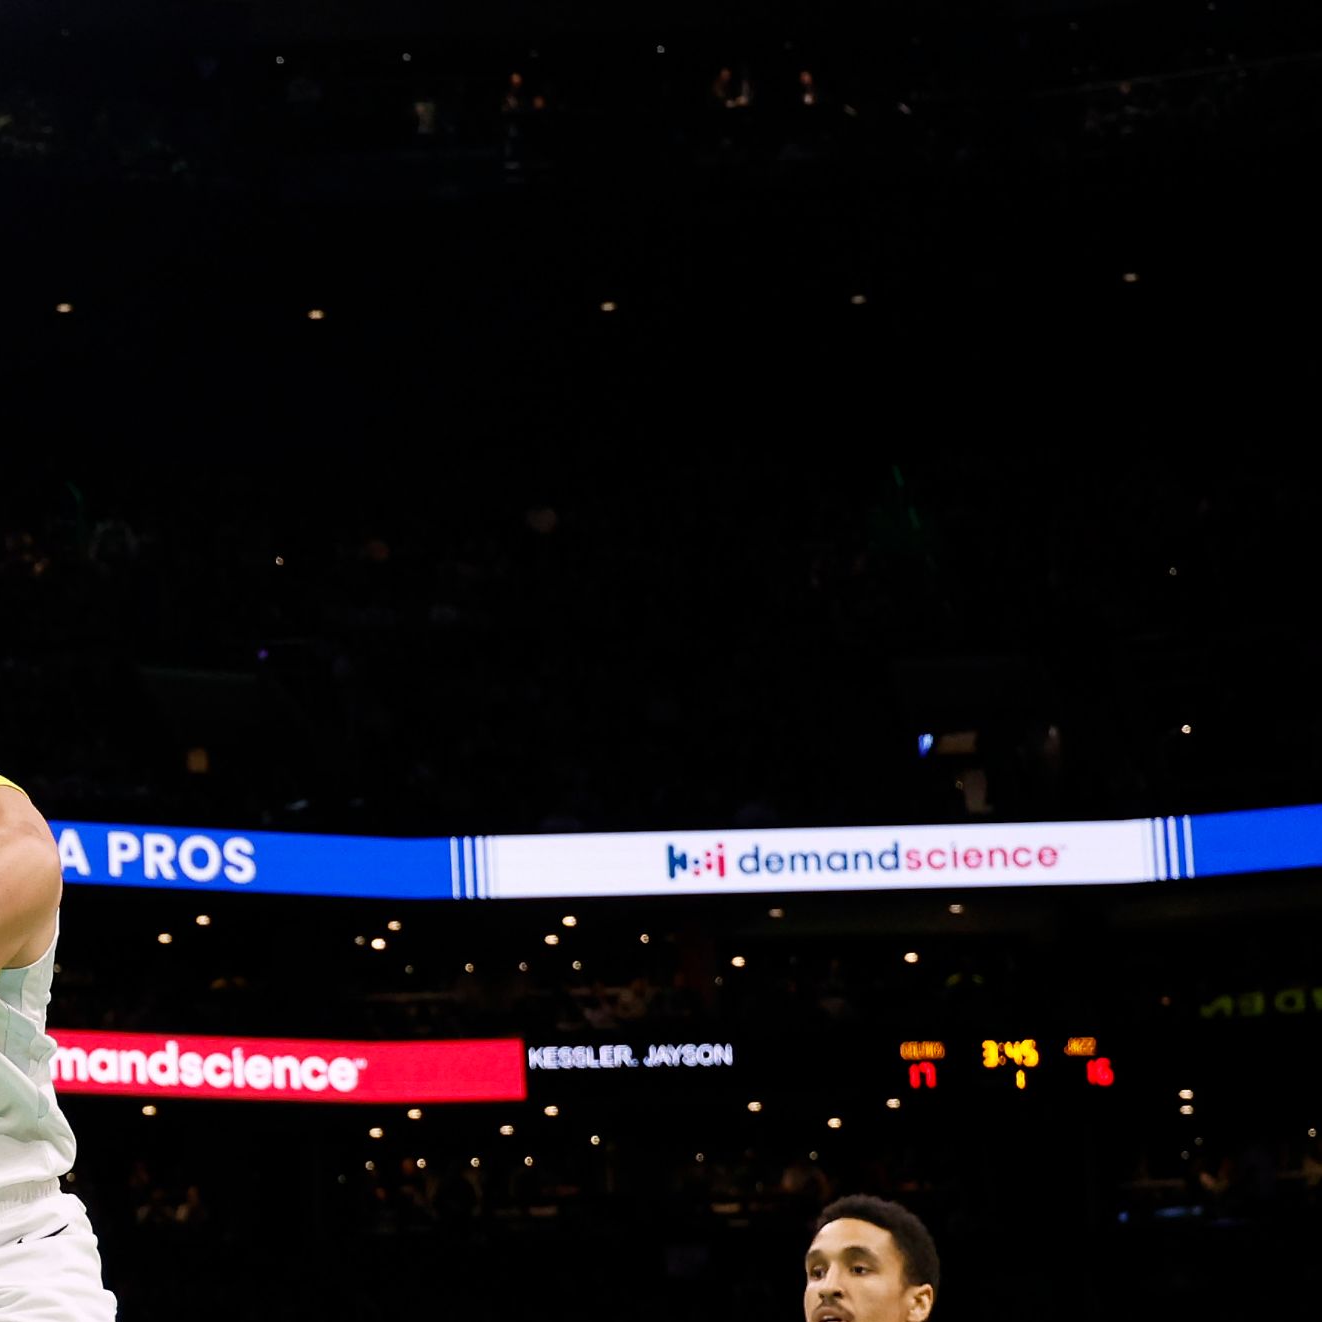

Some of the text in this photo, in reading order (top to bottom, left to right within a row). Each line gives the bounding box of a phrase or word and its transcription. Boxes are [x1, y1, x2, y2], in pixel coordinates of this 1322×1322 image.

[107, 830, 256, 885] PROS
[737, 841, 1060, 876] demandscience
[643, 1043, 734, 1068] JAYSON
